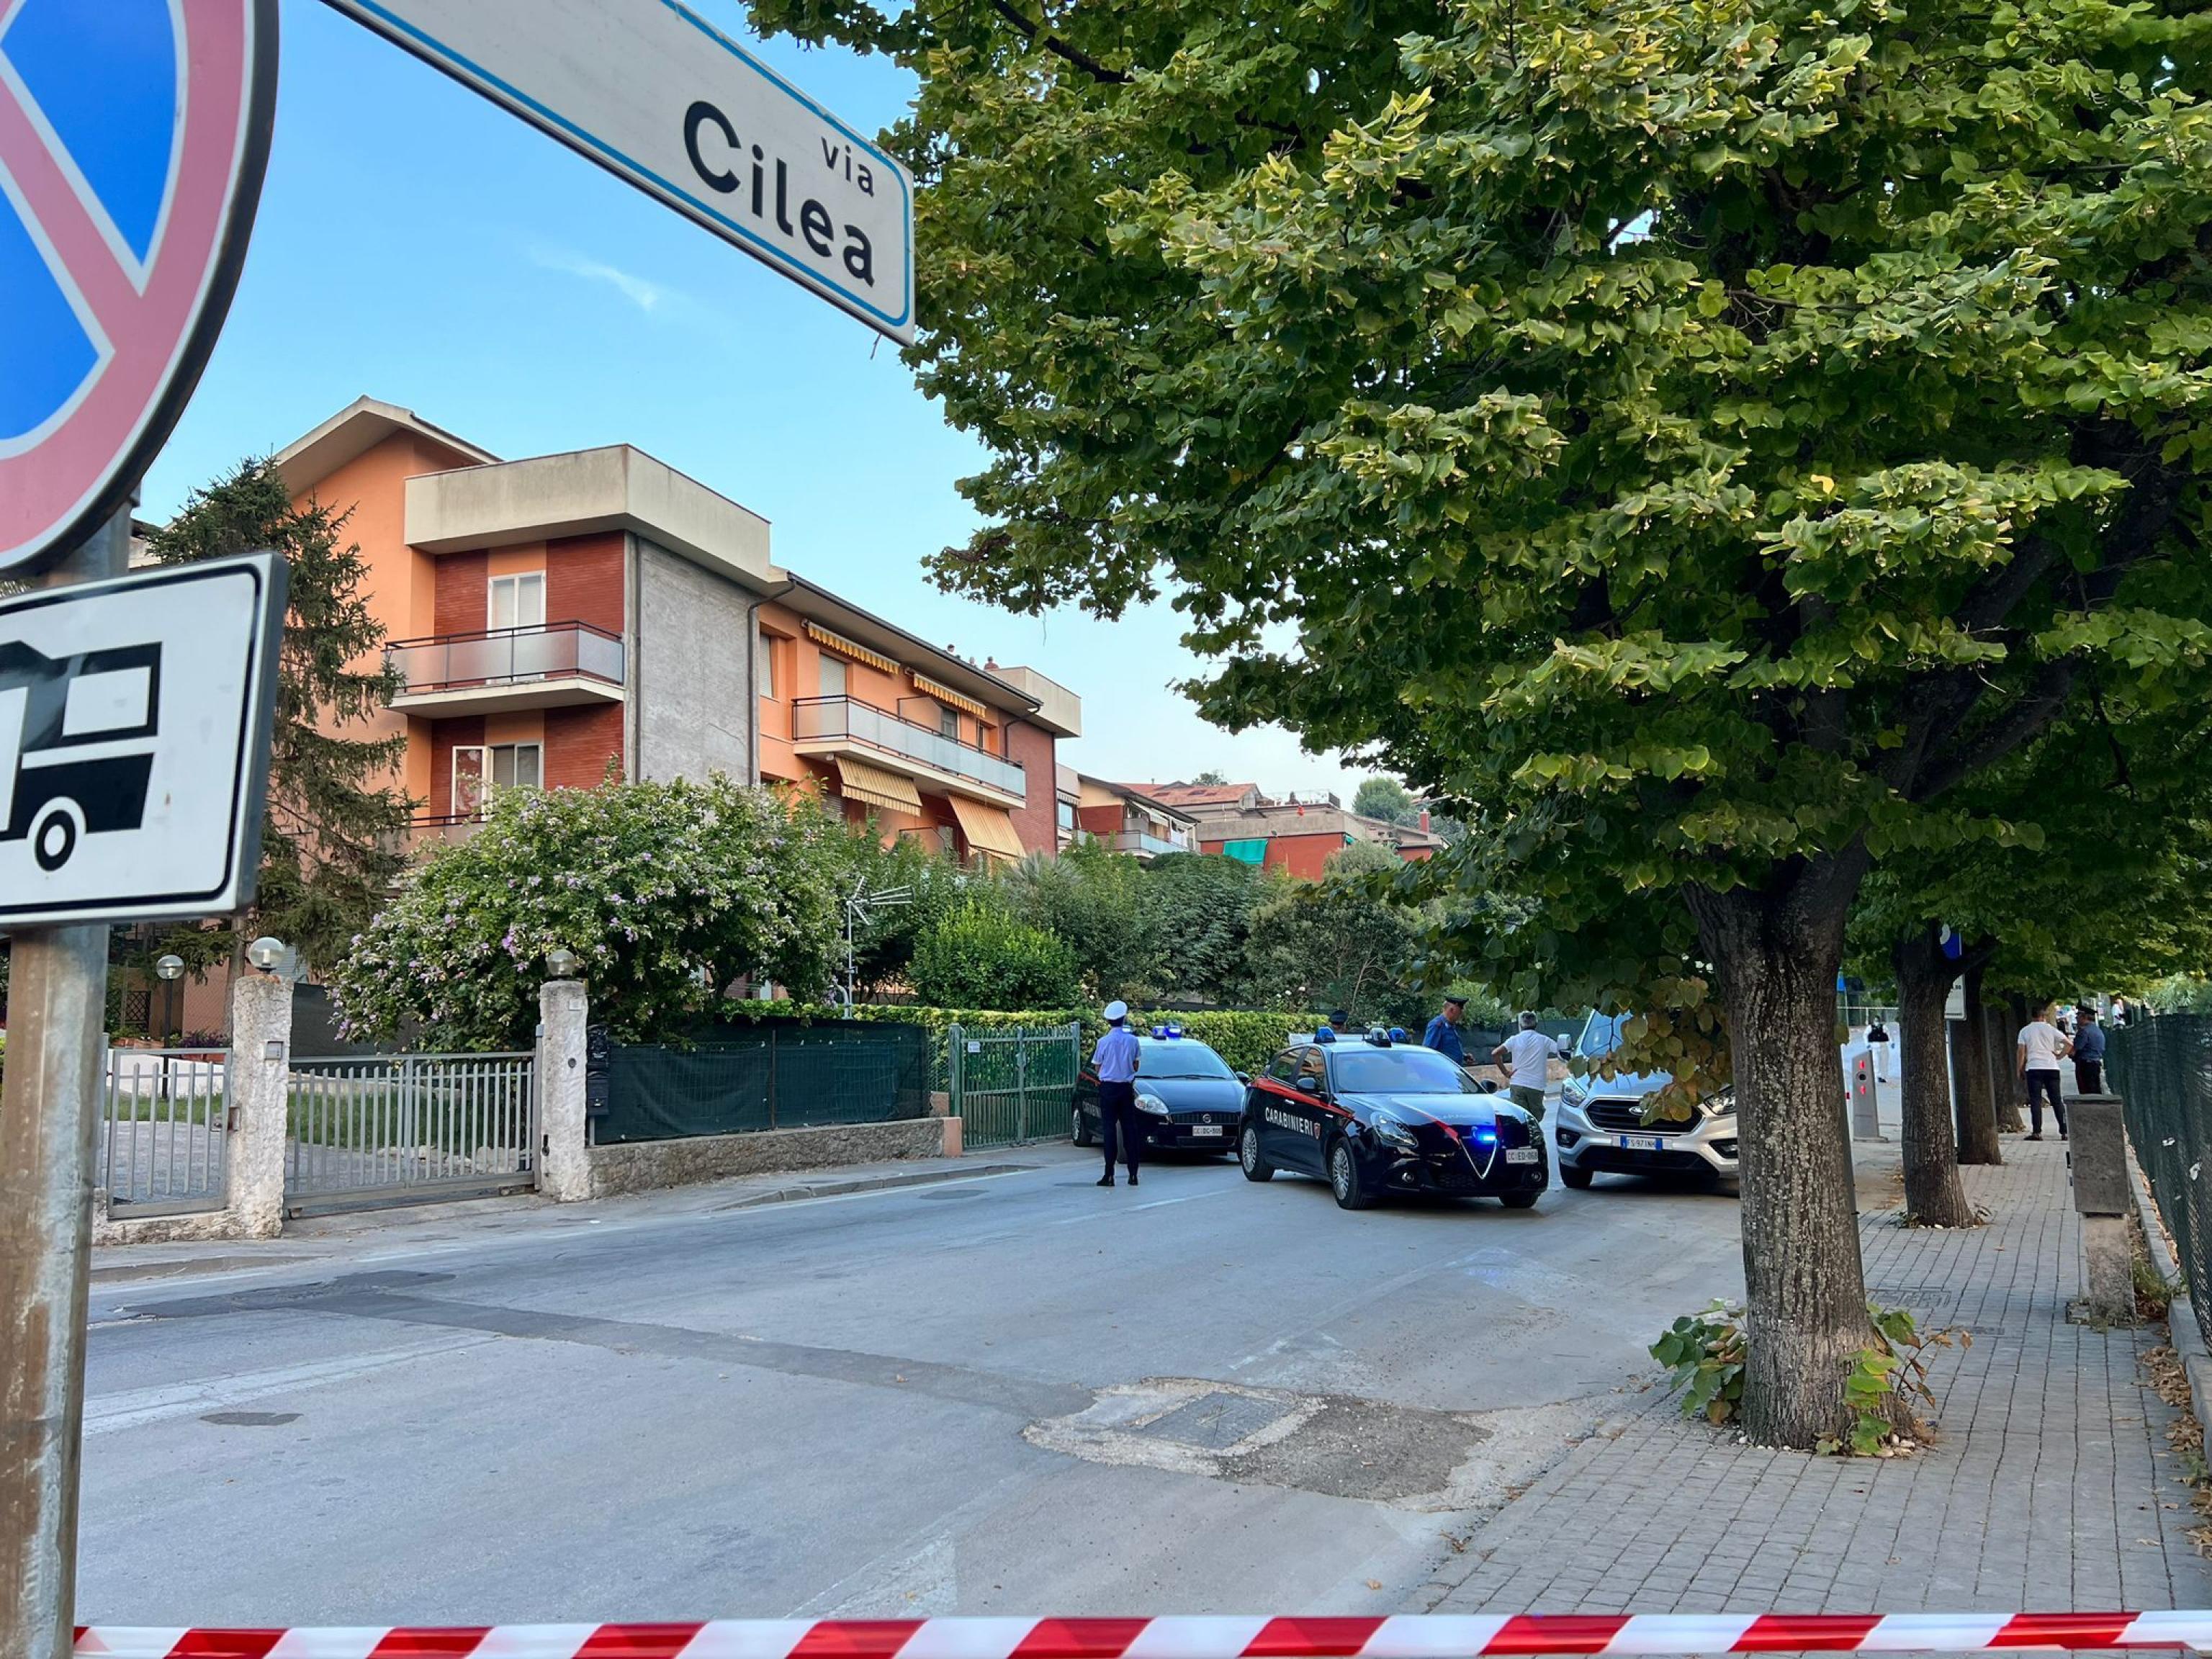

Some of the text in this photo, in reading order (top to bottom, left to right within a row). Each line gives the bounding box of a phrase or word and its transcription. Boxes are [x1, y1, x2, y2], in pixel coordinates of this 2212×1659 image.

[684, 101, 875, 287] Cilea
[821, 136, 873, 198] via
[1265, 1107, 1313, 1136] CARABINIERI
